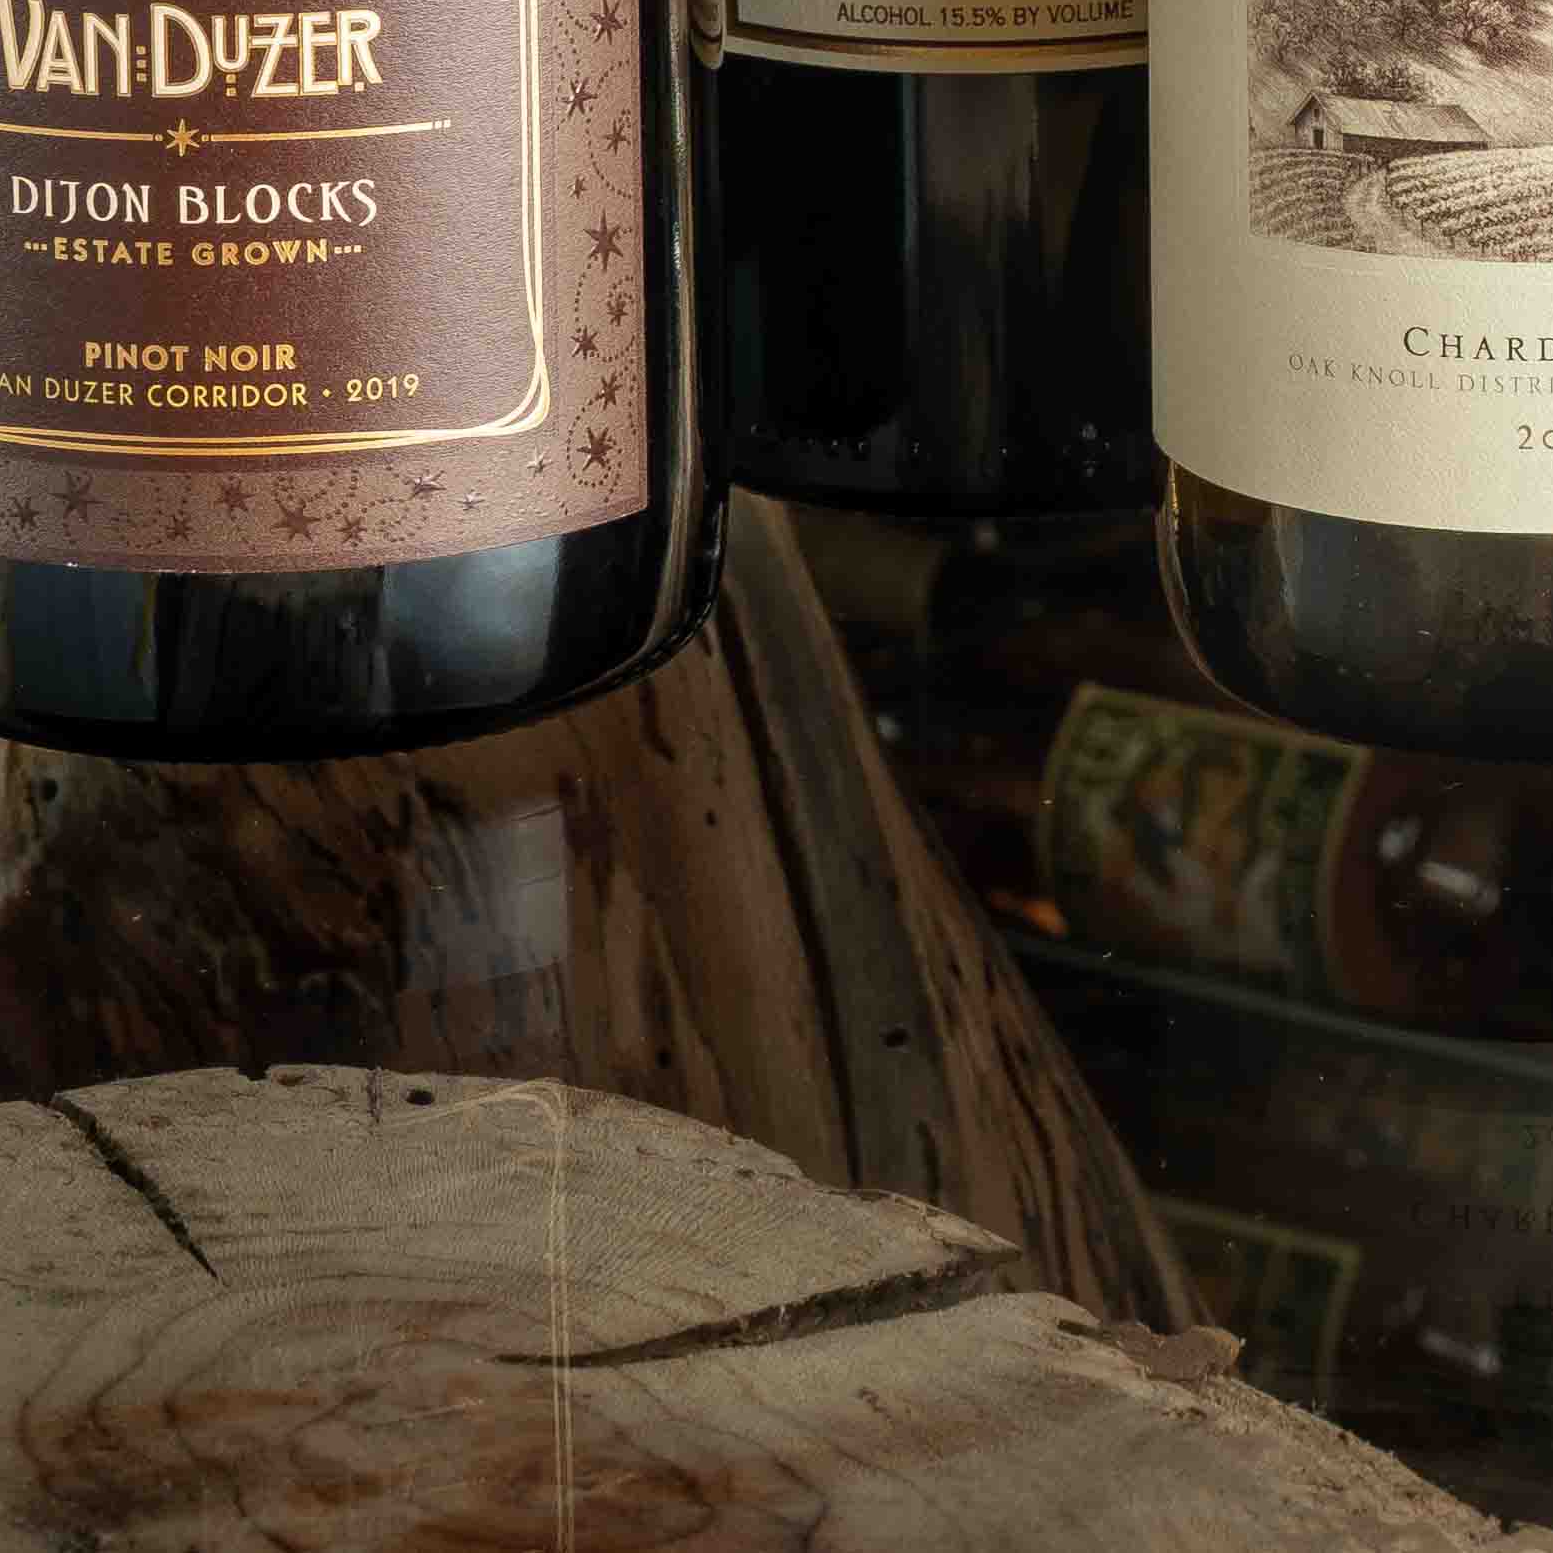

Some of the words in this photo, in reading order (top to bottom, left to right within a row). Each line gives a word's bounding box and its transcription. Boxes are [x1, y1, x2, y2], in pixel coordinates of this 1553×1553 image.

[836, 2, 932, 27] ALCOHOL
[939, 5, 1006, 28] 15.5%
[1013, 4, 1040, 26] BY
[149, 0, 385, 100] DUZER
[11, 175, 151, 225] DIJON
[178, 178, 380, 229] BLOCKS
[53, 237, 174, 266] ESTATE
[191, 237, 330, 266] GROWN
[83, 340, 190, 373] PINOT
[202, 344, 297, 373] NOIR
[1288, 354, 1338, 378] OAK
[1350, 362, 1442, 391] KNOLL
[44, 377, 135, 408] DUZER
[146, 380, 308, 409] CORRIDOR
[345, 371, 420, 403] 2019
